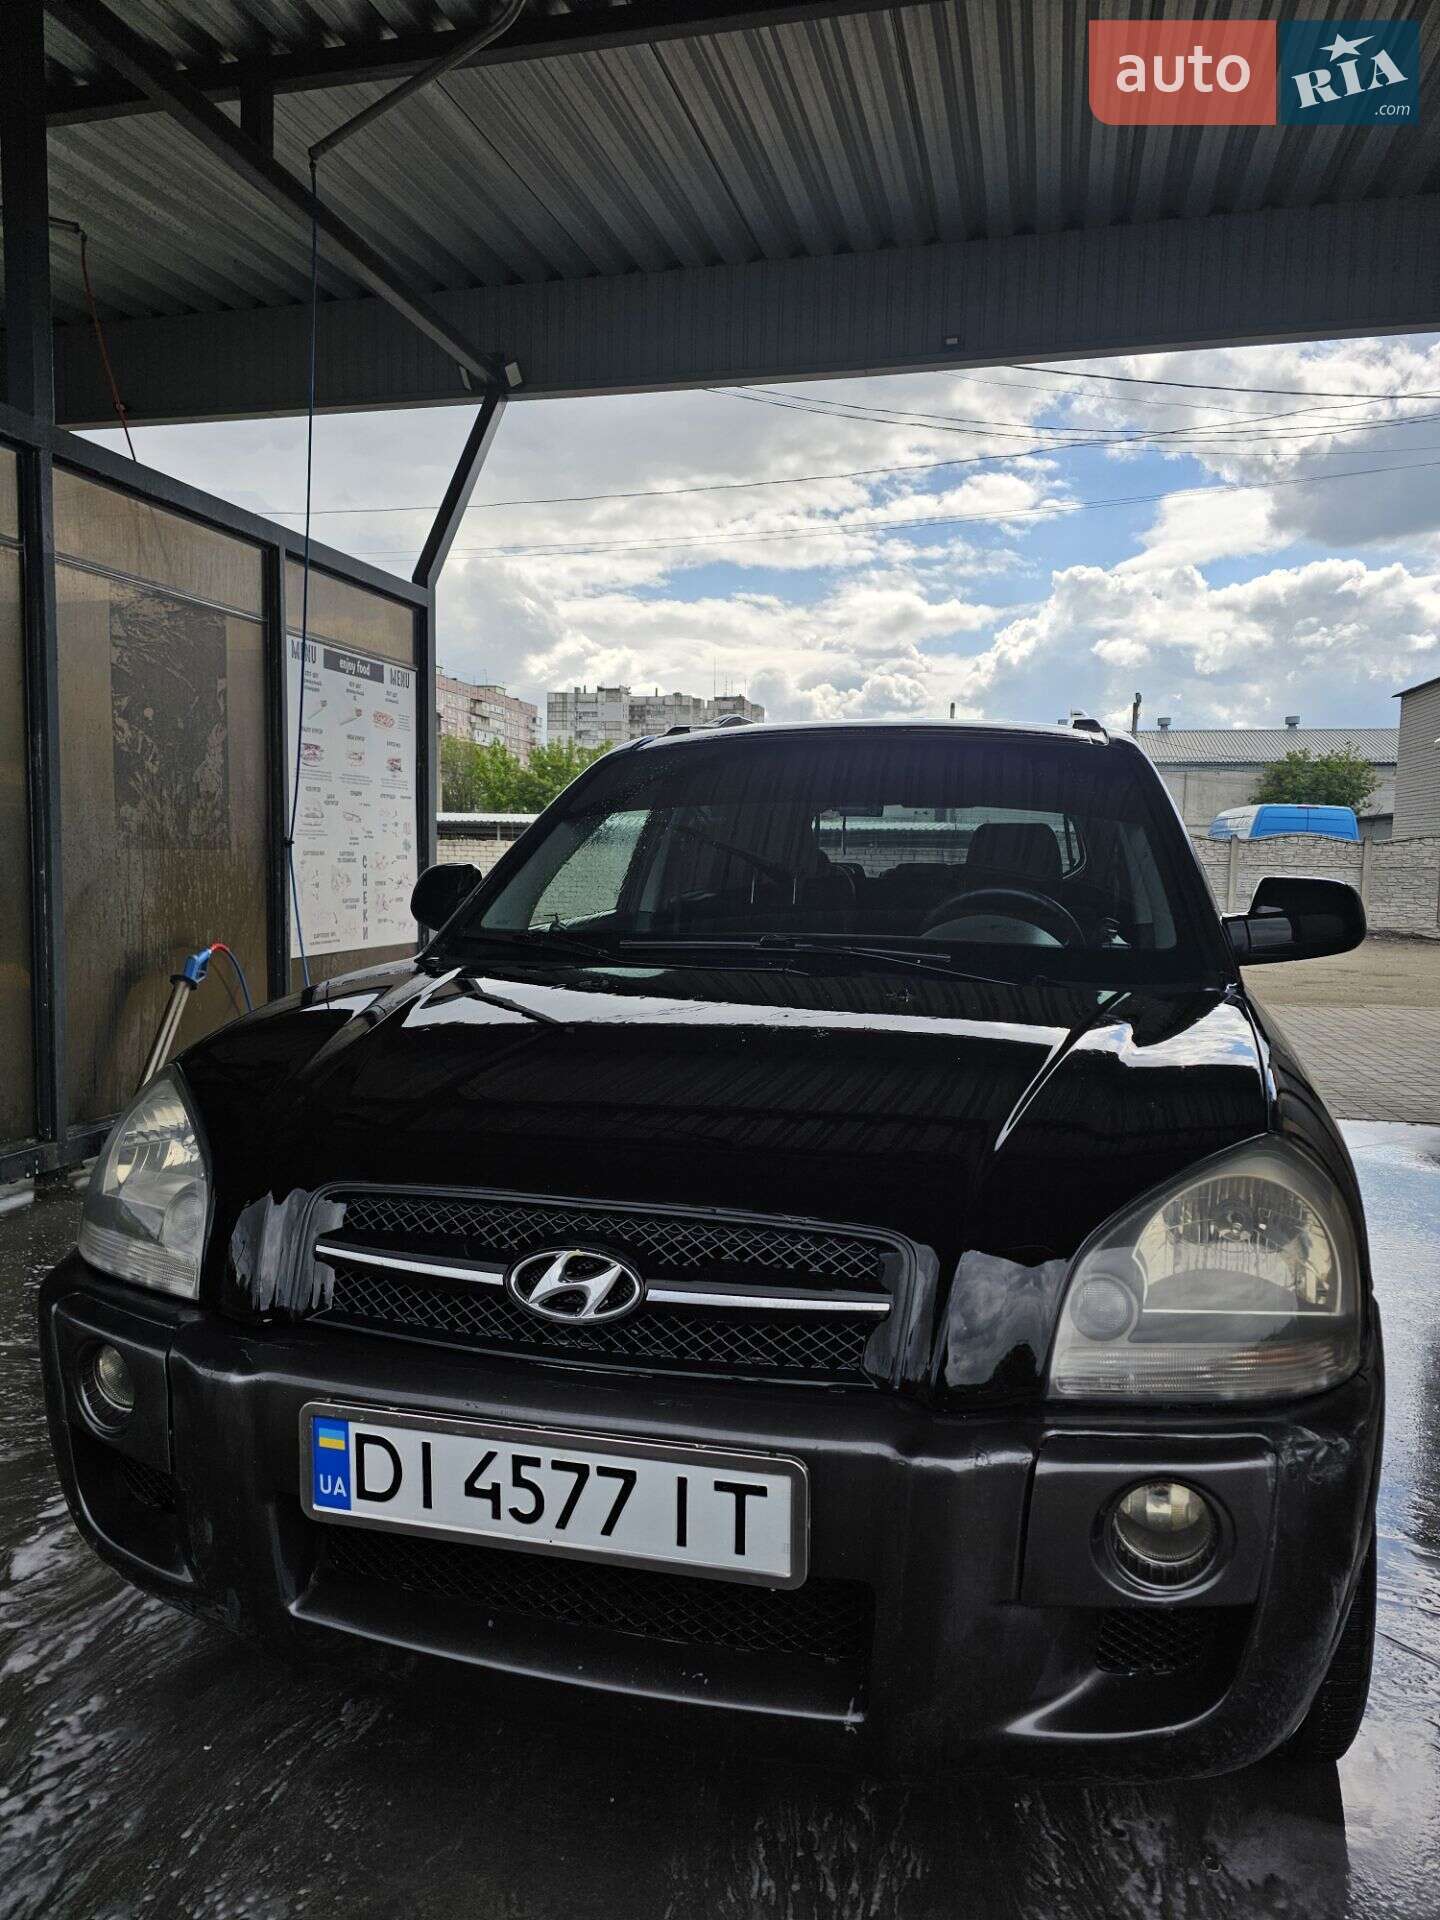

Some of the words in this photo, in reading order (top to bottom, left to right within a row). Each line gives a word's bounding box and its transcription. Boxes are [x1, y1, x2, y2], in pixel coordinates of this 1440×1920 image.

[291, 639, 317, 664] MNU
[339, 657, 356, 675] enjoy
[357, 660, 371, 677] food
[390, 667, 410, 689] MENU
[319, 1474, 347, 1498] UA
[355, 1432, 433, 1510] DI
[464, 1450, 638, 1537] 4577
[676, 1475, 769, 1556] IT
